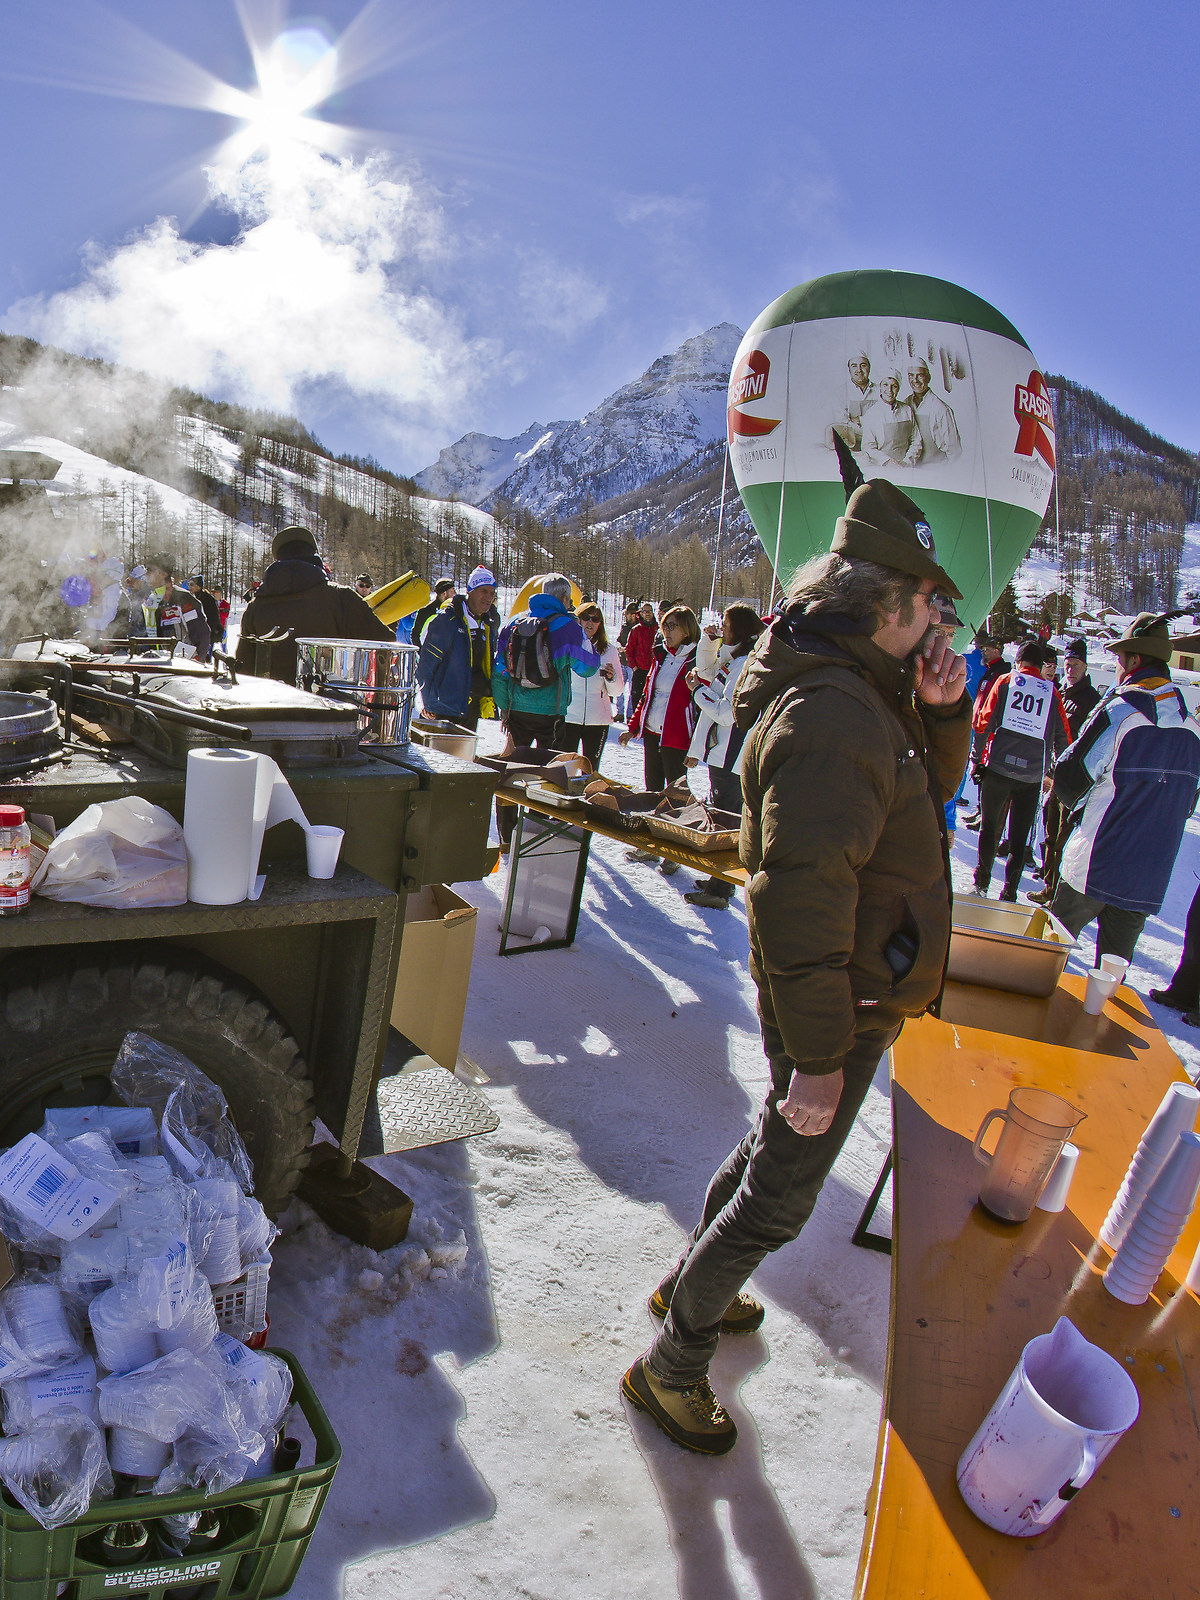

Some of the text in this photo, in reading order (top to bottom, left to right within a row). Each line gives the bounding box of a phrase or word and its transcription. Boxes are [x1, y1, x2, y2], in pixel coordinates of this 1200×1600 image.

[1011, 690, 1045, 717] 201
[104, 1561, 221, 1587] BUSSOLINO
[129, 1572, 205, 1589] SOMMARIVA
